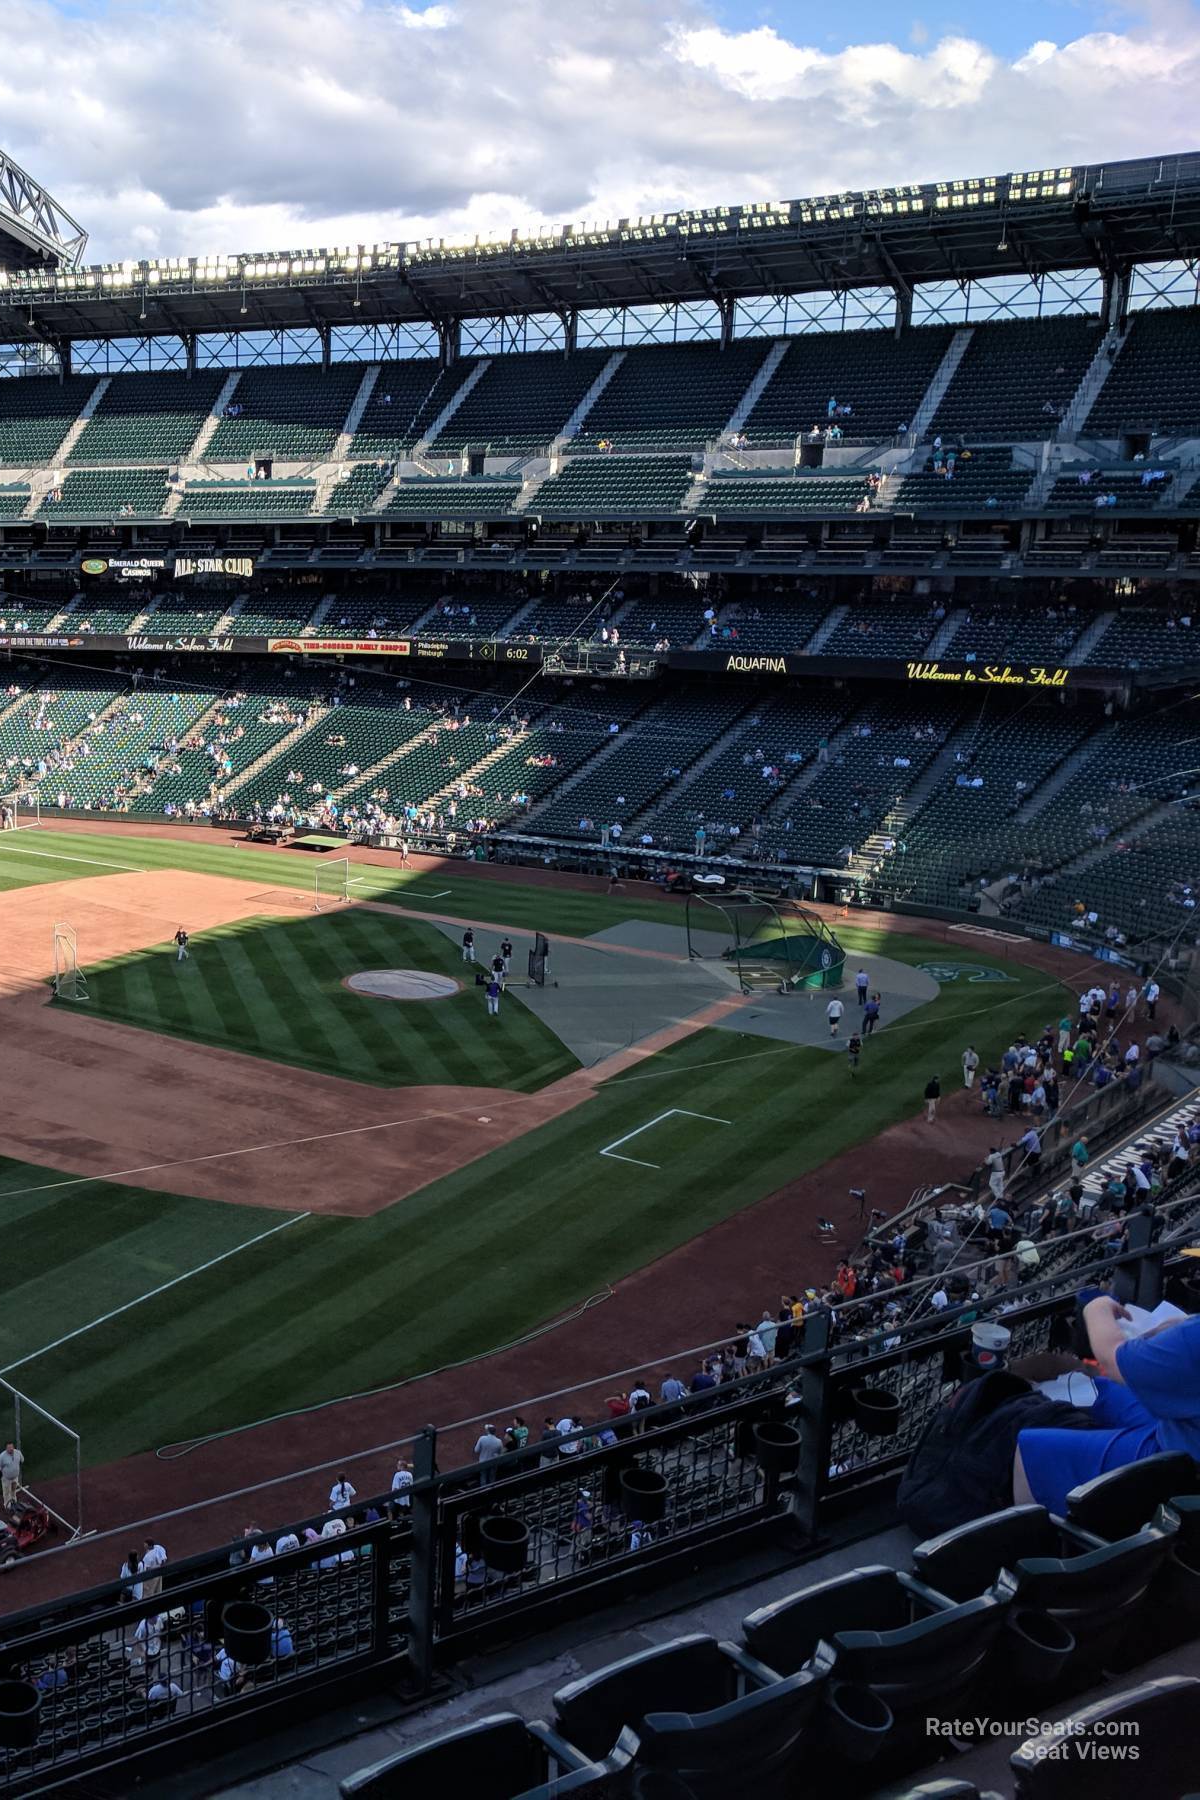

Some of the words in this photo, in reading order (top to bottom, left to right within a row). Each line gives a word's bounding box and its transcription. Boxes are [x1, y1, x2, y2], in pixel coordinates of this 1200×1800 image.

[109, 559, 139, 568] EMERALD
[140, 559, 165, 568] QUEEN
[225, 558, 253, 577] CLUB
[121, 568, 151, 577] CASINOS
[127, 637, 163, 650] Welcome
[165, 640, 173, 649] to
[175, 638, 205, 651] Safeco
[206, 637, 234, 651] Field
[418, 642, 448, 650] Philadelphia
[506, 649, 528, 659] 6:02
[727, 656, 786, 673] AQUAFINA
[907, 663, 961, 682] Welcome
[964, 669, 976, 681] to
[978, 667, 1024, 684] Safeco
[1027, 667, 1069, 686] Field
